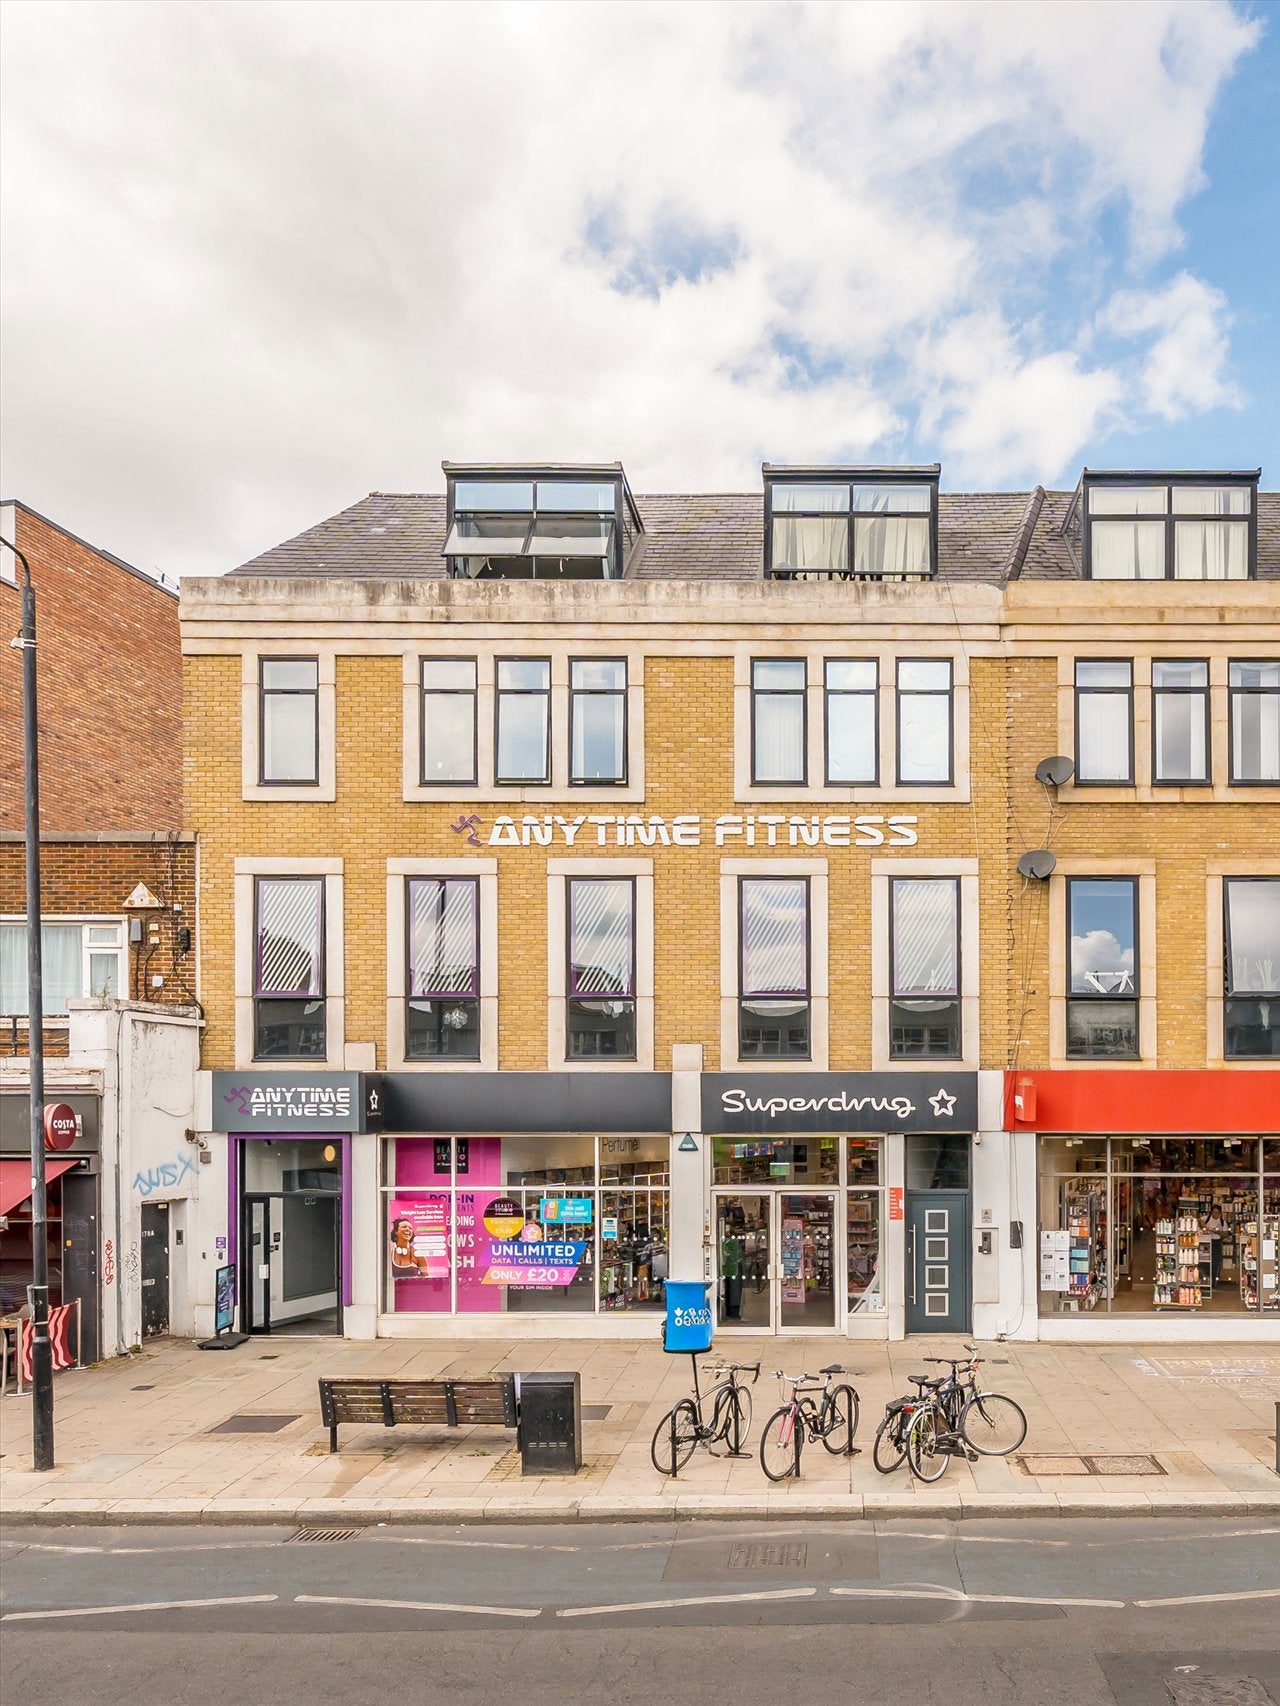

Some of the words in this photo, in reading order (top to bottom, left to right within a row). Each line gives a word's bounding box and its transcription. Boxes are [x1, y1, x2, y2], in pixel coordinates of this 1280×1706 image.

[487, 815, 701, 846] ANYTIME
[715, 815, 919, 846] FITNESS
[250, 1087, 350, 1103] ANYTIME
[251, 1104, 350, 1117] FITNESS
[721, 1089, 917, 1118] Superdrug
[52, 1119, 75, 1130] COSTA
[491, 1244, 576, 1257] UNLIMITED
[490, 1270, 523, 1280] ONLY
[526, 1268, 559, 1282] £20
